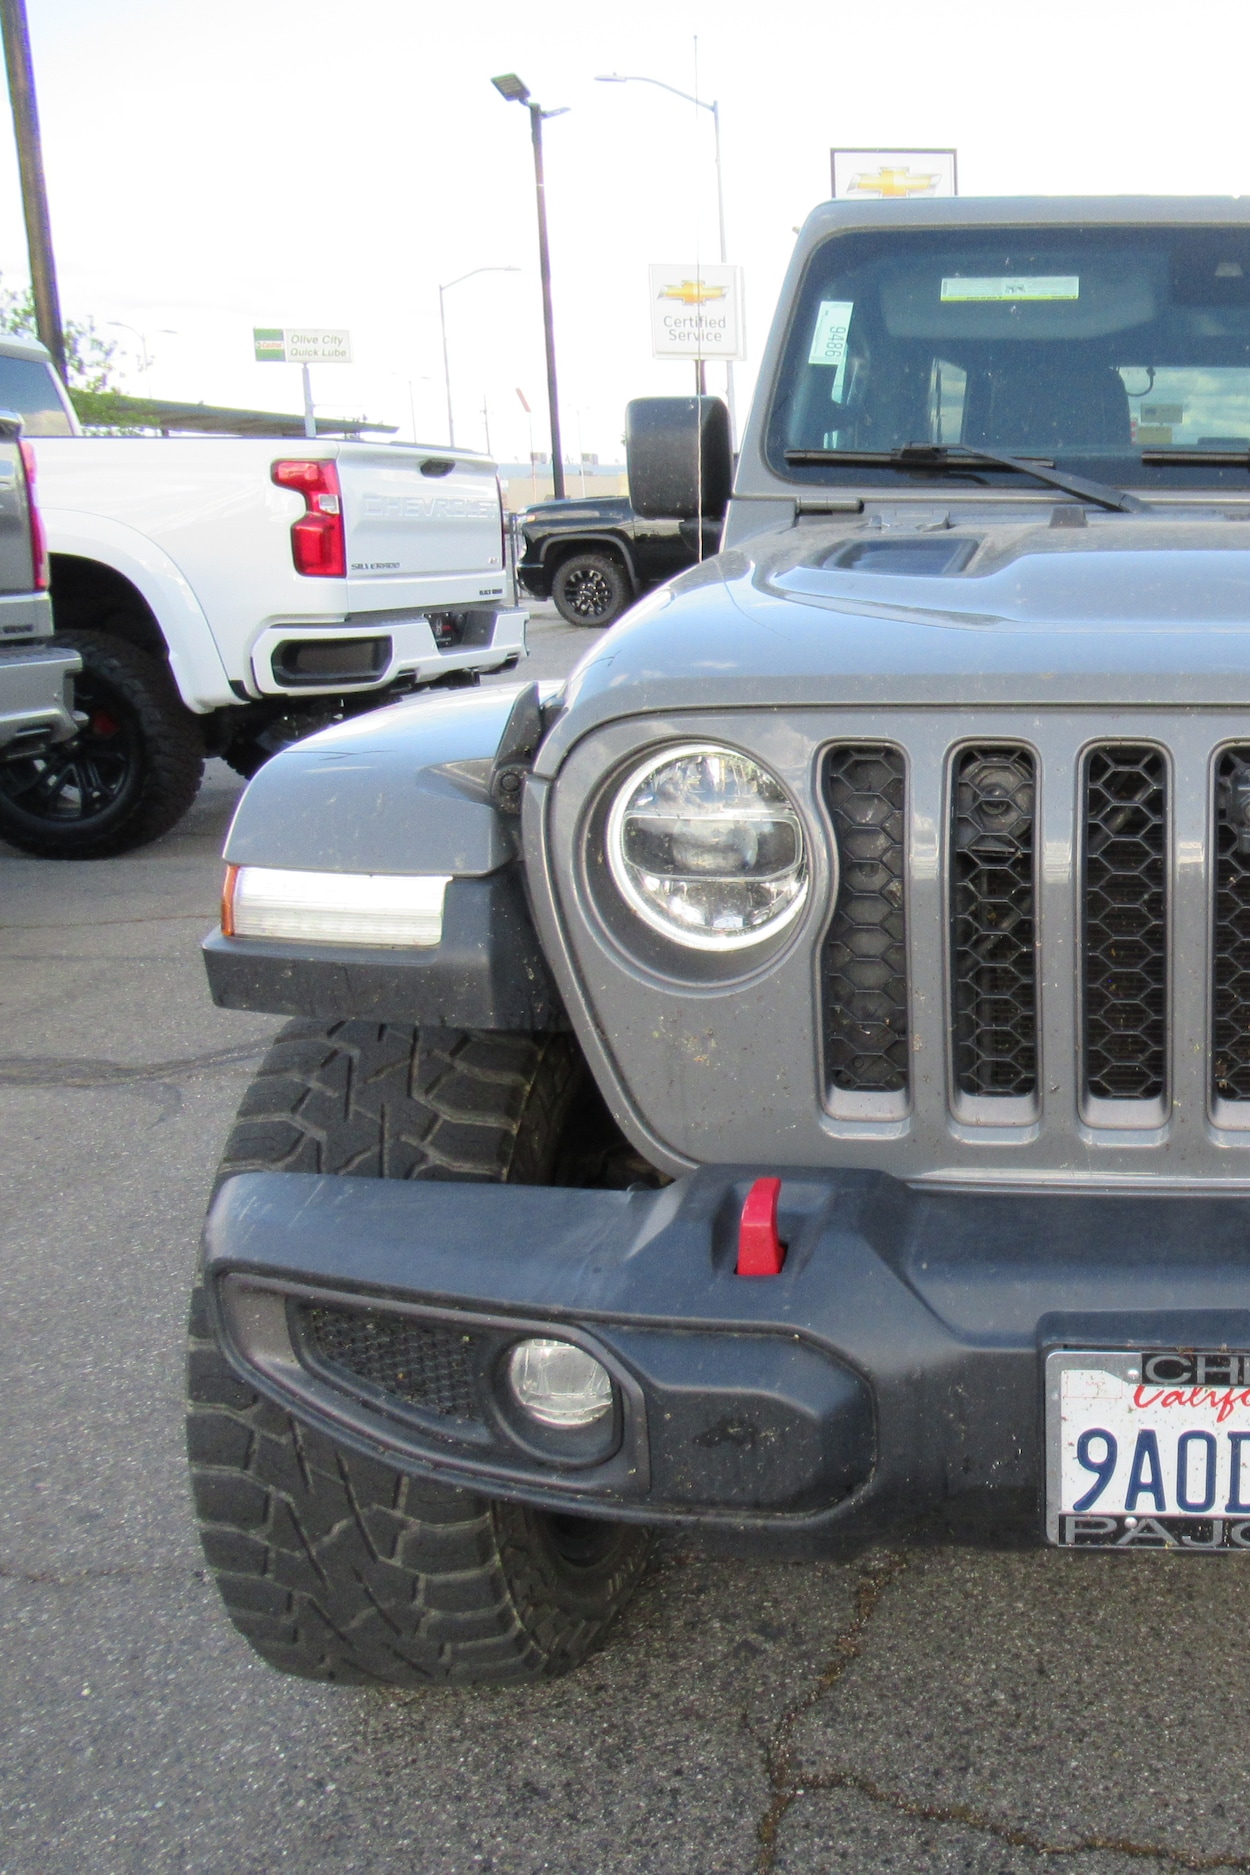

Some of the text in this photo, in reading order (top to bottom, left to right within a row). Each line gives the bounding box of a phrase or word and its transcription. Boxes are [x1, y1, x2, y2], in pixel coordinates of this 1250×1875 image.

[663, 315, 726, 328] Certified
[291, 334, 344, 346] Olive City
[668, 328, 722, 341] Service
[825, 327, 847, 358] 9486
[290, 348, 347, 357] Quick Lube
[362, 495, 498, 519] CHEVROLET
[351, 562, 401, 570] SILVERADO
